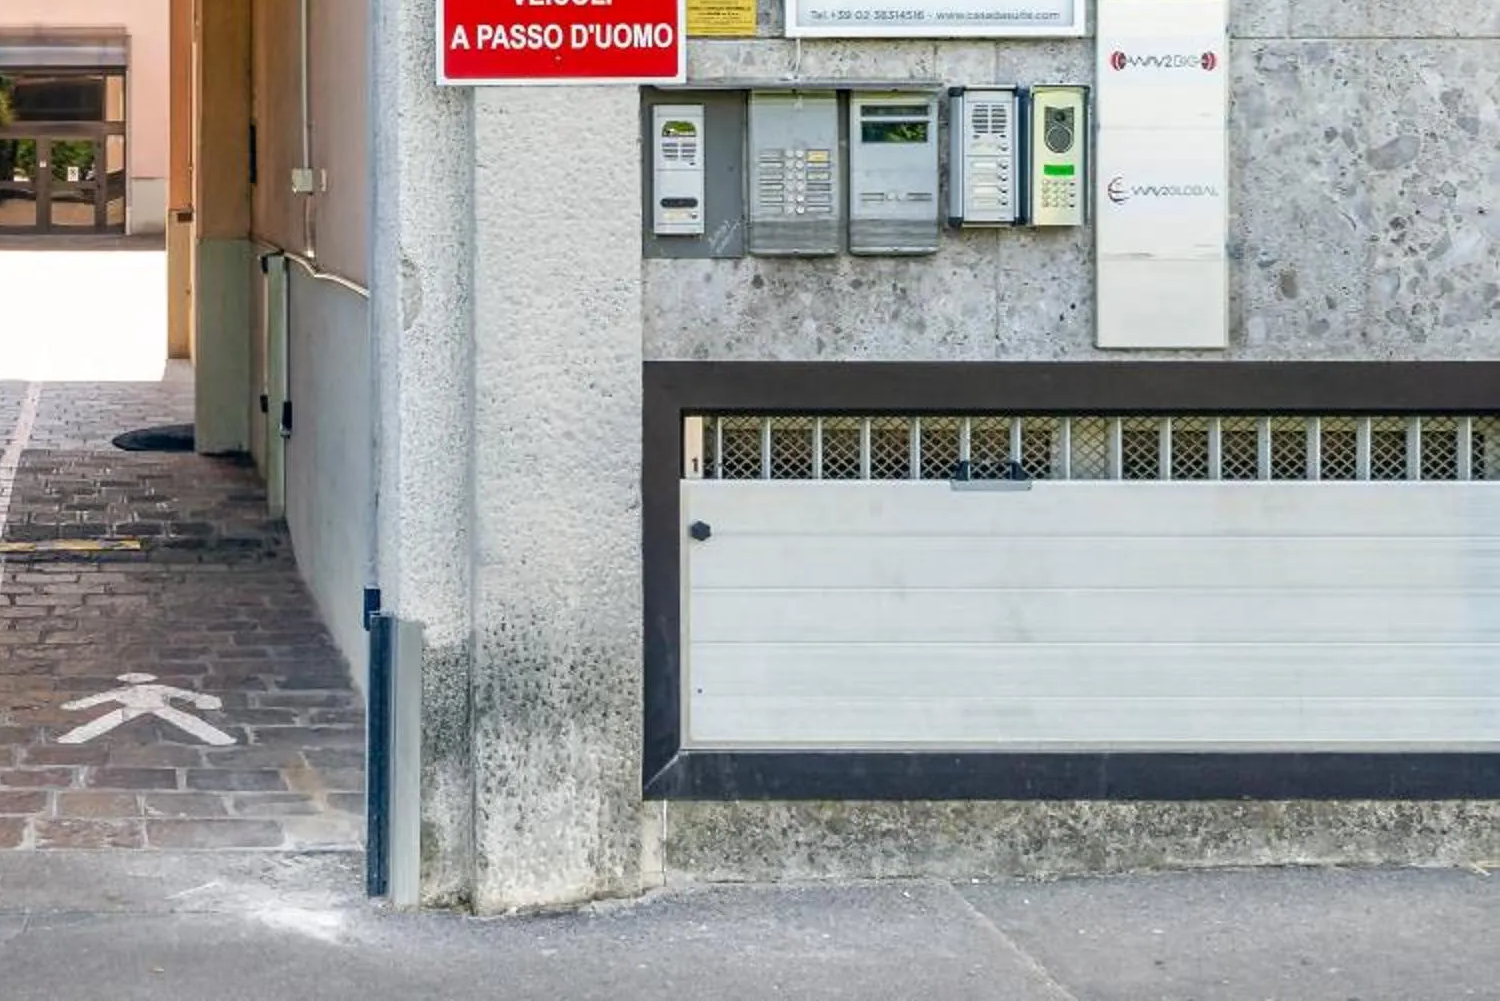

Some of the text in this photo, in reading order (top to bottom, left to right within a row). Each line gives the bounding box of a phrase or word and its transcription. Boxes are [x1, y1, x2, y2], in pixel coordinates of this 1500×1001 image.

[450, 23, 674, 50] A PASSO D'UOMO
